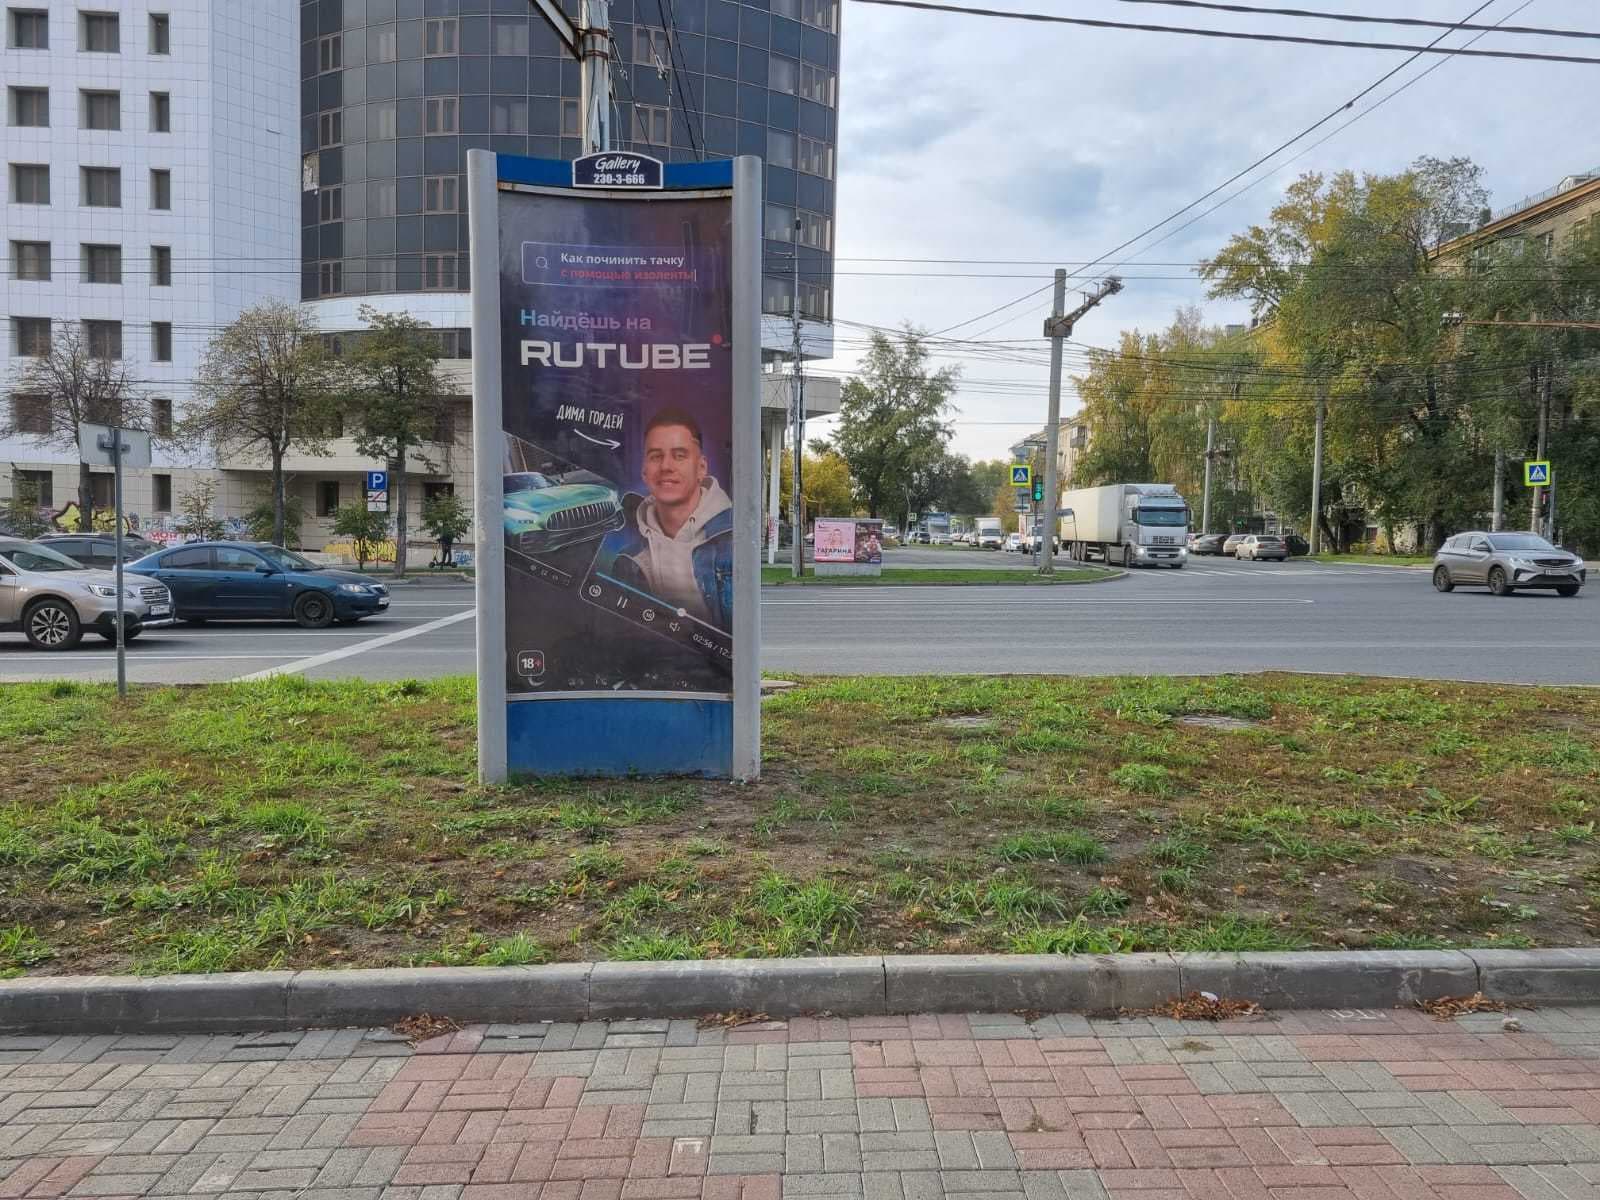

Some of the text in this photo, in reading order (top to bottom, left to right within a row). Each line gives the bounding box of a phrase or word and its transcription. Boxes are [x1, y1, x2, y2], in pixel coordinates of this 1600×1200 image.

[595, 156, 641, 173] Gallery
[560, 252, 685, 268] Как починить тачку
[560, 269, 694, 281] с помощью изоленты
[520, 309, 652, 331] Найдёшь на
[520, 339, 711, 370] RUTUBE
[556, 404, 625, 430] ДИМА ГОРДЕЙ
[521, 657, 543, 669] 18+
